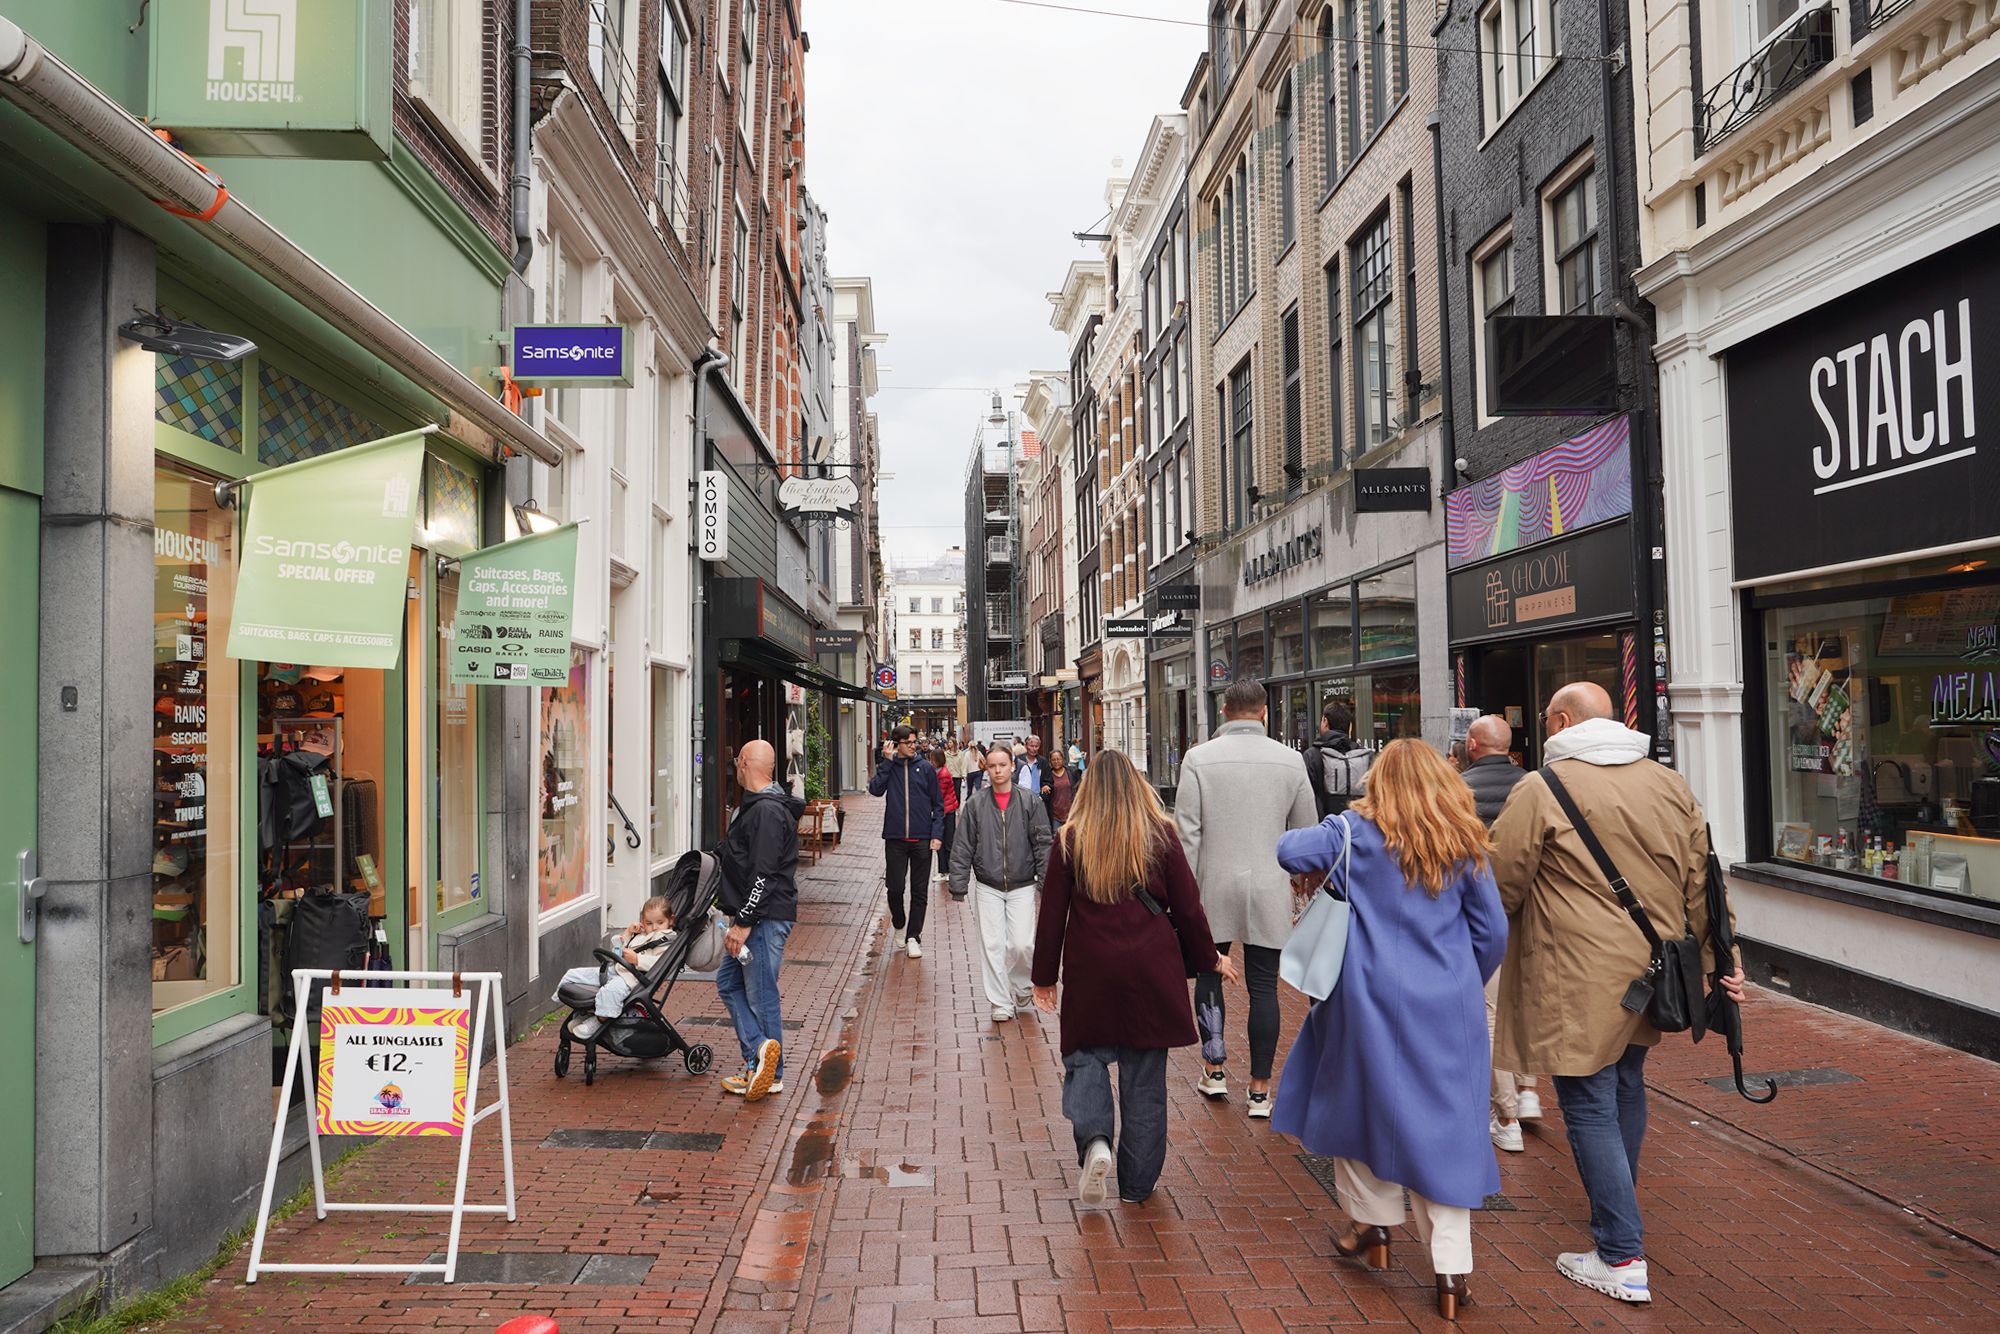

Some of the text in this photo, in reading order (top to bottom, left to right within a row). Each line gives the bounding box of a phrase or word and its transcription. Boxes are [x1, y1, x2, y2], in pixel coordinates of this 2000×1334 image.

[206, 81, 295, 103] HOUSE44
[522, 345, 616, 361] Samsonite
[1810, 298, 1976, 480] STACH
[806, 482, 852, 499] English
[1361, 484, 1426, 494] ALLSAINTS
[705, 476, 717, 553] KOMONO
[809, 511, 829, 519] 1935
[154, 527, 219, 568] HOUSE44
[254, 534, 403, 565] Samsonite
[1243, 526, 1322, 587] ALLSAINTS
[277, 563, 376, 585] SPECIAL OFFER
[473, 566, 565, 584] Suitcases, Bags,
[1512, 549, 1571, 595] CHOOSE
[468, 580, 568, 596] Caps, Accessories
[486, 595, 549, 609] and more!
[1519, 595, 1572, 612] HAPPINESS
[459, 609, 497, 617] Samsonite
[538, 629, 564, 639] RAINS
[1108, 624, 1147, 632] notbranded
[313, 632, 335, 643] CAPS
[1965, 624, 1997, 650] NEW
[458, 645, 492, 654] CASIO
[534, 647, 566, 655] SECRID
[1931, 671, 2000, 723] MELA
[174, 705, 206, 723] RAINS
[171, 731, 208, 746] SECRID
[184, 773, 197, 781] THE
[174, 805, 206, 822] THULE
[346, 1035, 444, 1047] ALL SUNGLASSES
[365, 1053, 424, 1075] €12,-
